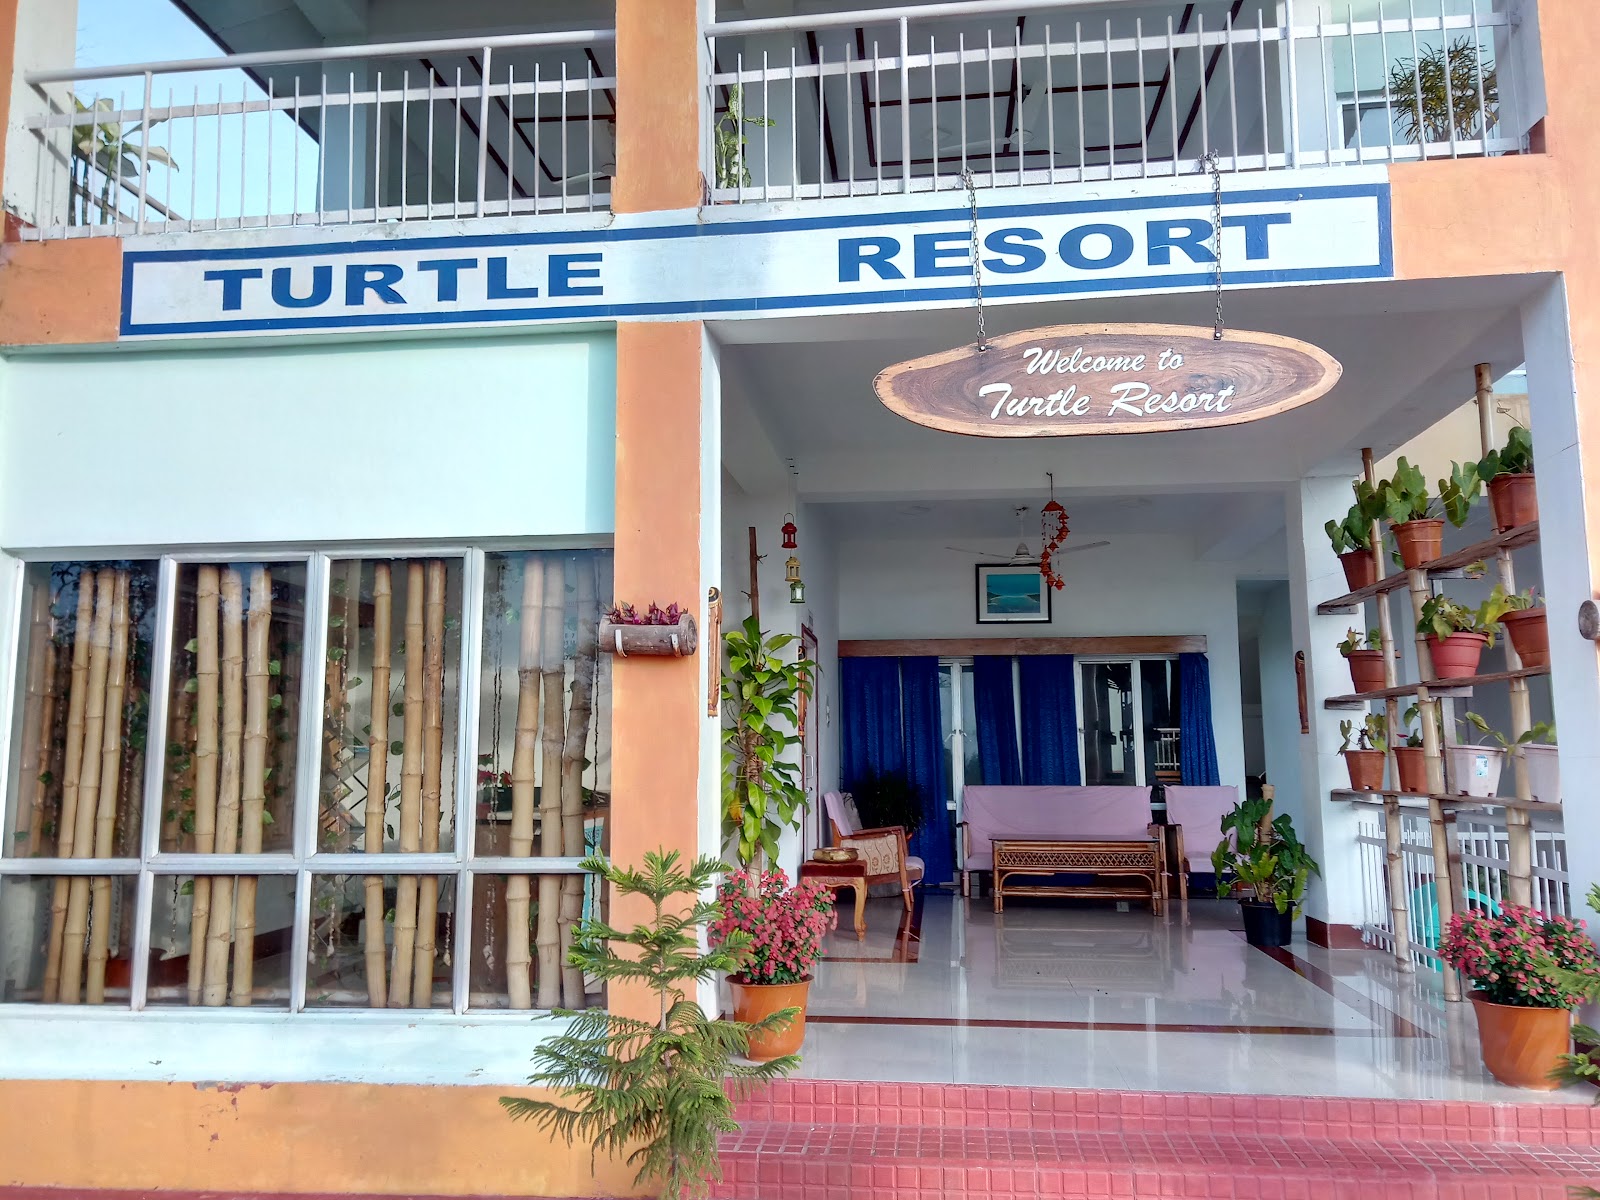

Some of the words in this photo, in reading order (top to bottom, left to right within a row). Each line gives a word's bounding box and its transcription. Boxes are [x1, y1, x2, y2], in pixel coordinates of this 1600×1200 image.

[205, 253, 603, 310] TURTLE
[839, 213, 1290, 282] RESORT
[1023, 346, 1146, 375] Welcome
[1158, 348, 1184, 371] to
[979, 383, 1091, 419] Turtle
[1108, 381, 1234, 417] Resort
